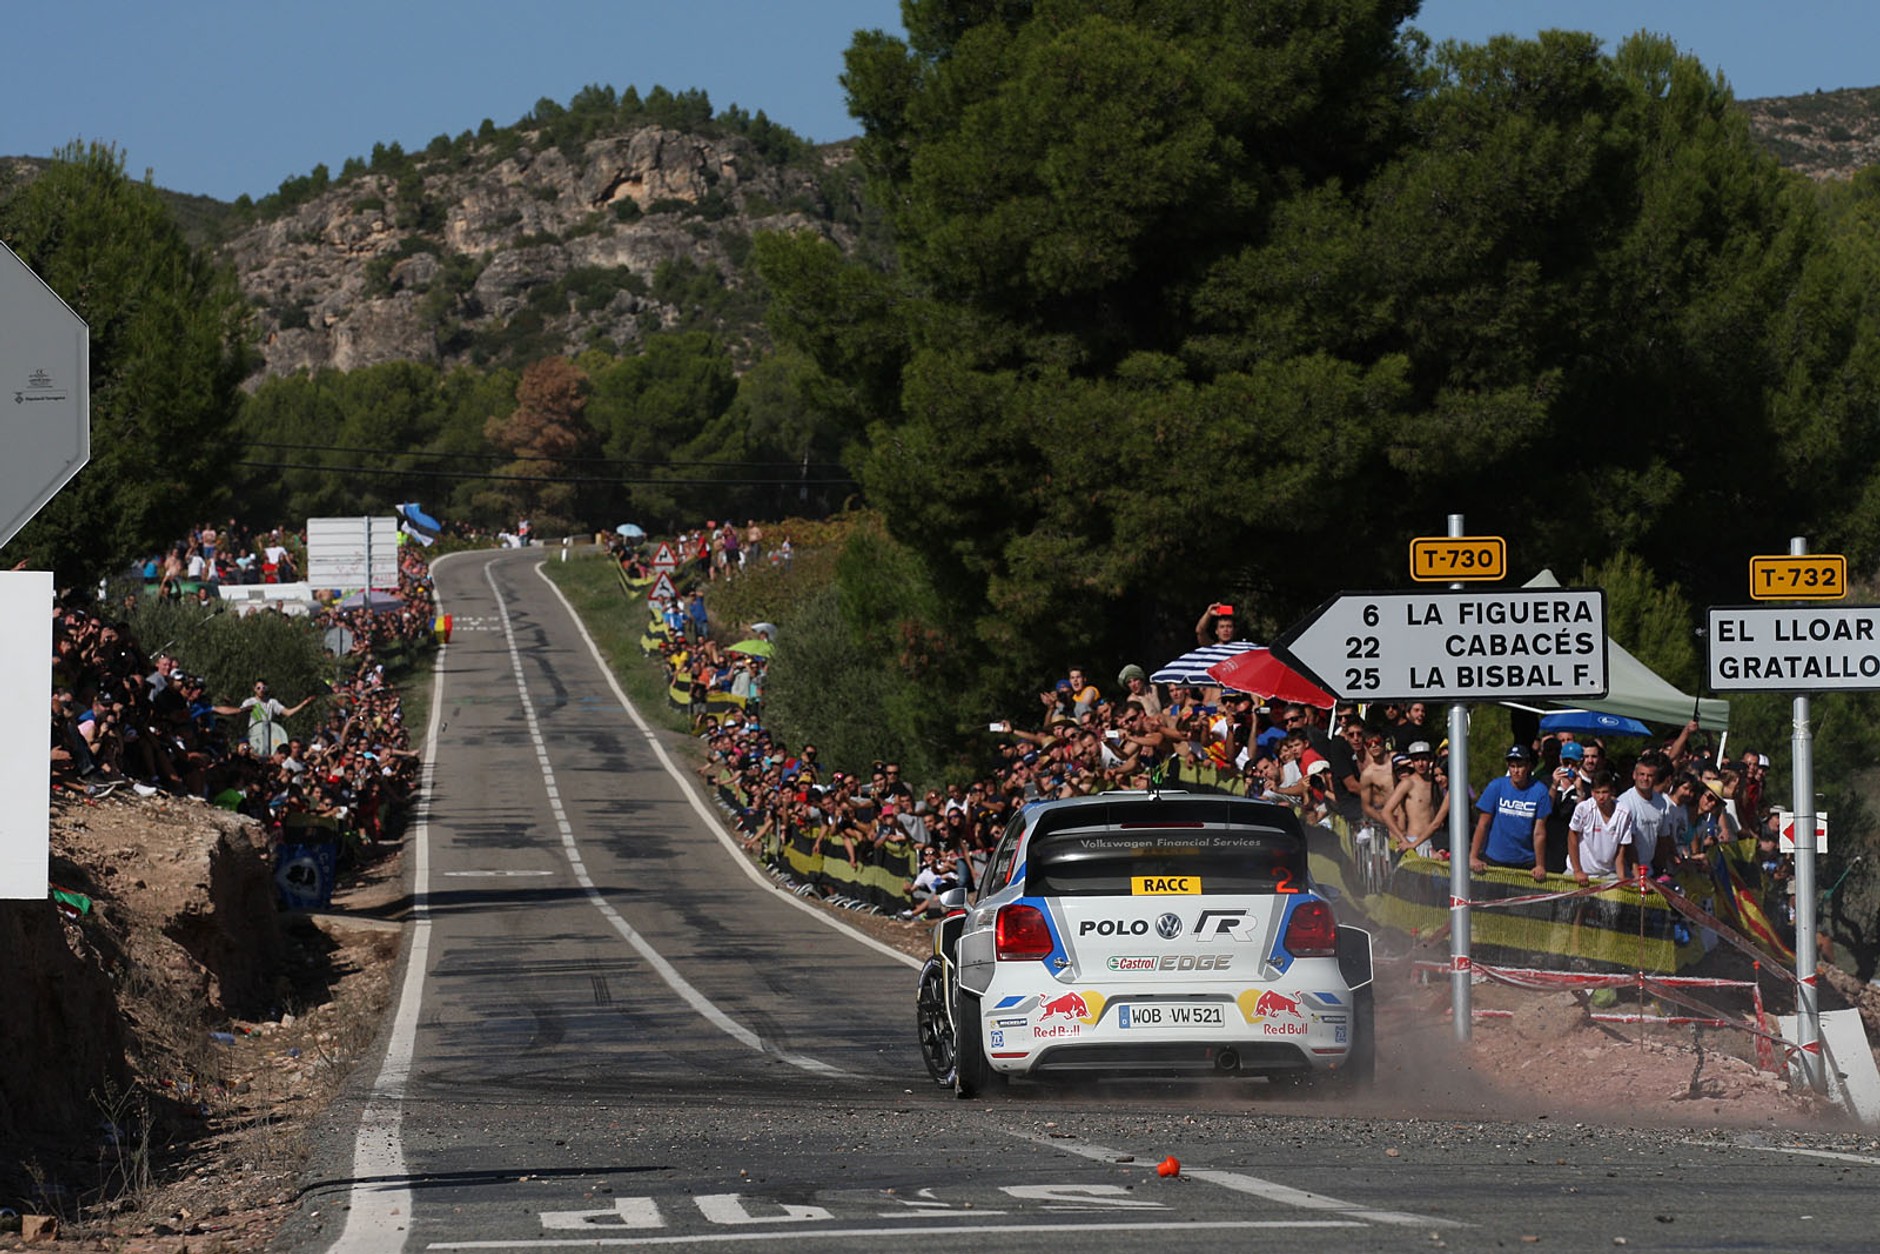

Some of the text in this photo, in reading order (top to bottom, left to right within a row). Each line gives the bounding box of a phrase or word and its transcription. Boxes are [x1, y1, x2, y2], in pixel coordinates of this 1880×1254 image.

[1423, 549, 1494, 568] T-730
[1760, 567, 1837, 588] T-732
[1363, 600, 1593, 627] 6 LA FIGUERA
[1718, 618, 1874, 642] EL LLOAR
[1345, 627, 1595, 659] 22 CABACÉS
[1345, 664, 1595, 690] 25 LA BISBAL F.
[1499, 796, 1537, 811] WRC
[1081, 837, 1261, 849] Volkswagen Financial Services
[1143, 878, 1189, 892] RACC
[1271, 866, 1299, 893] 2
[1079, 920, 1149, 936] POLO
[1119, 954, 1234, 971] Castrol EDGE
[1132, 1008, 1162, 1024] WOB
[1034, 1025, 1057, 1038] Red
[1264, 1023, 1308, 1035] Red Bull
